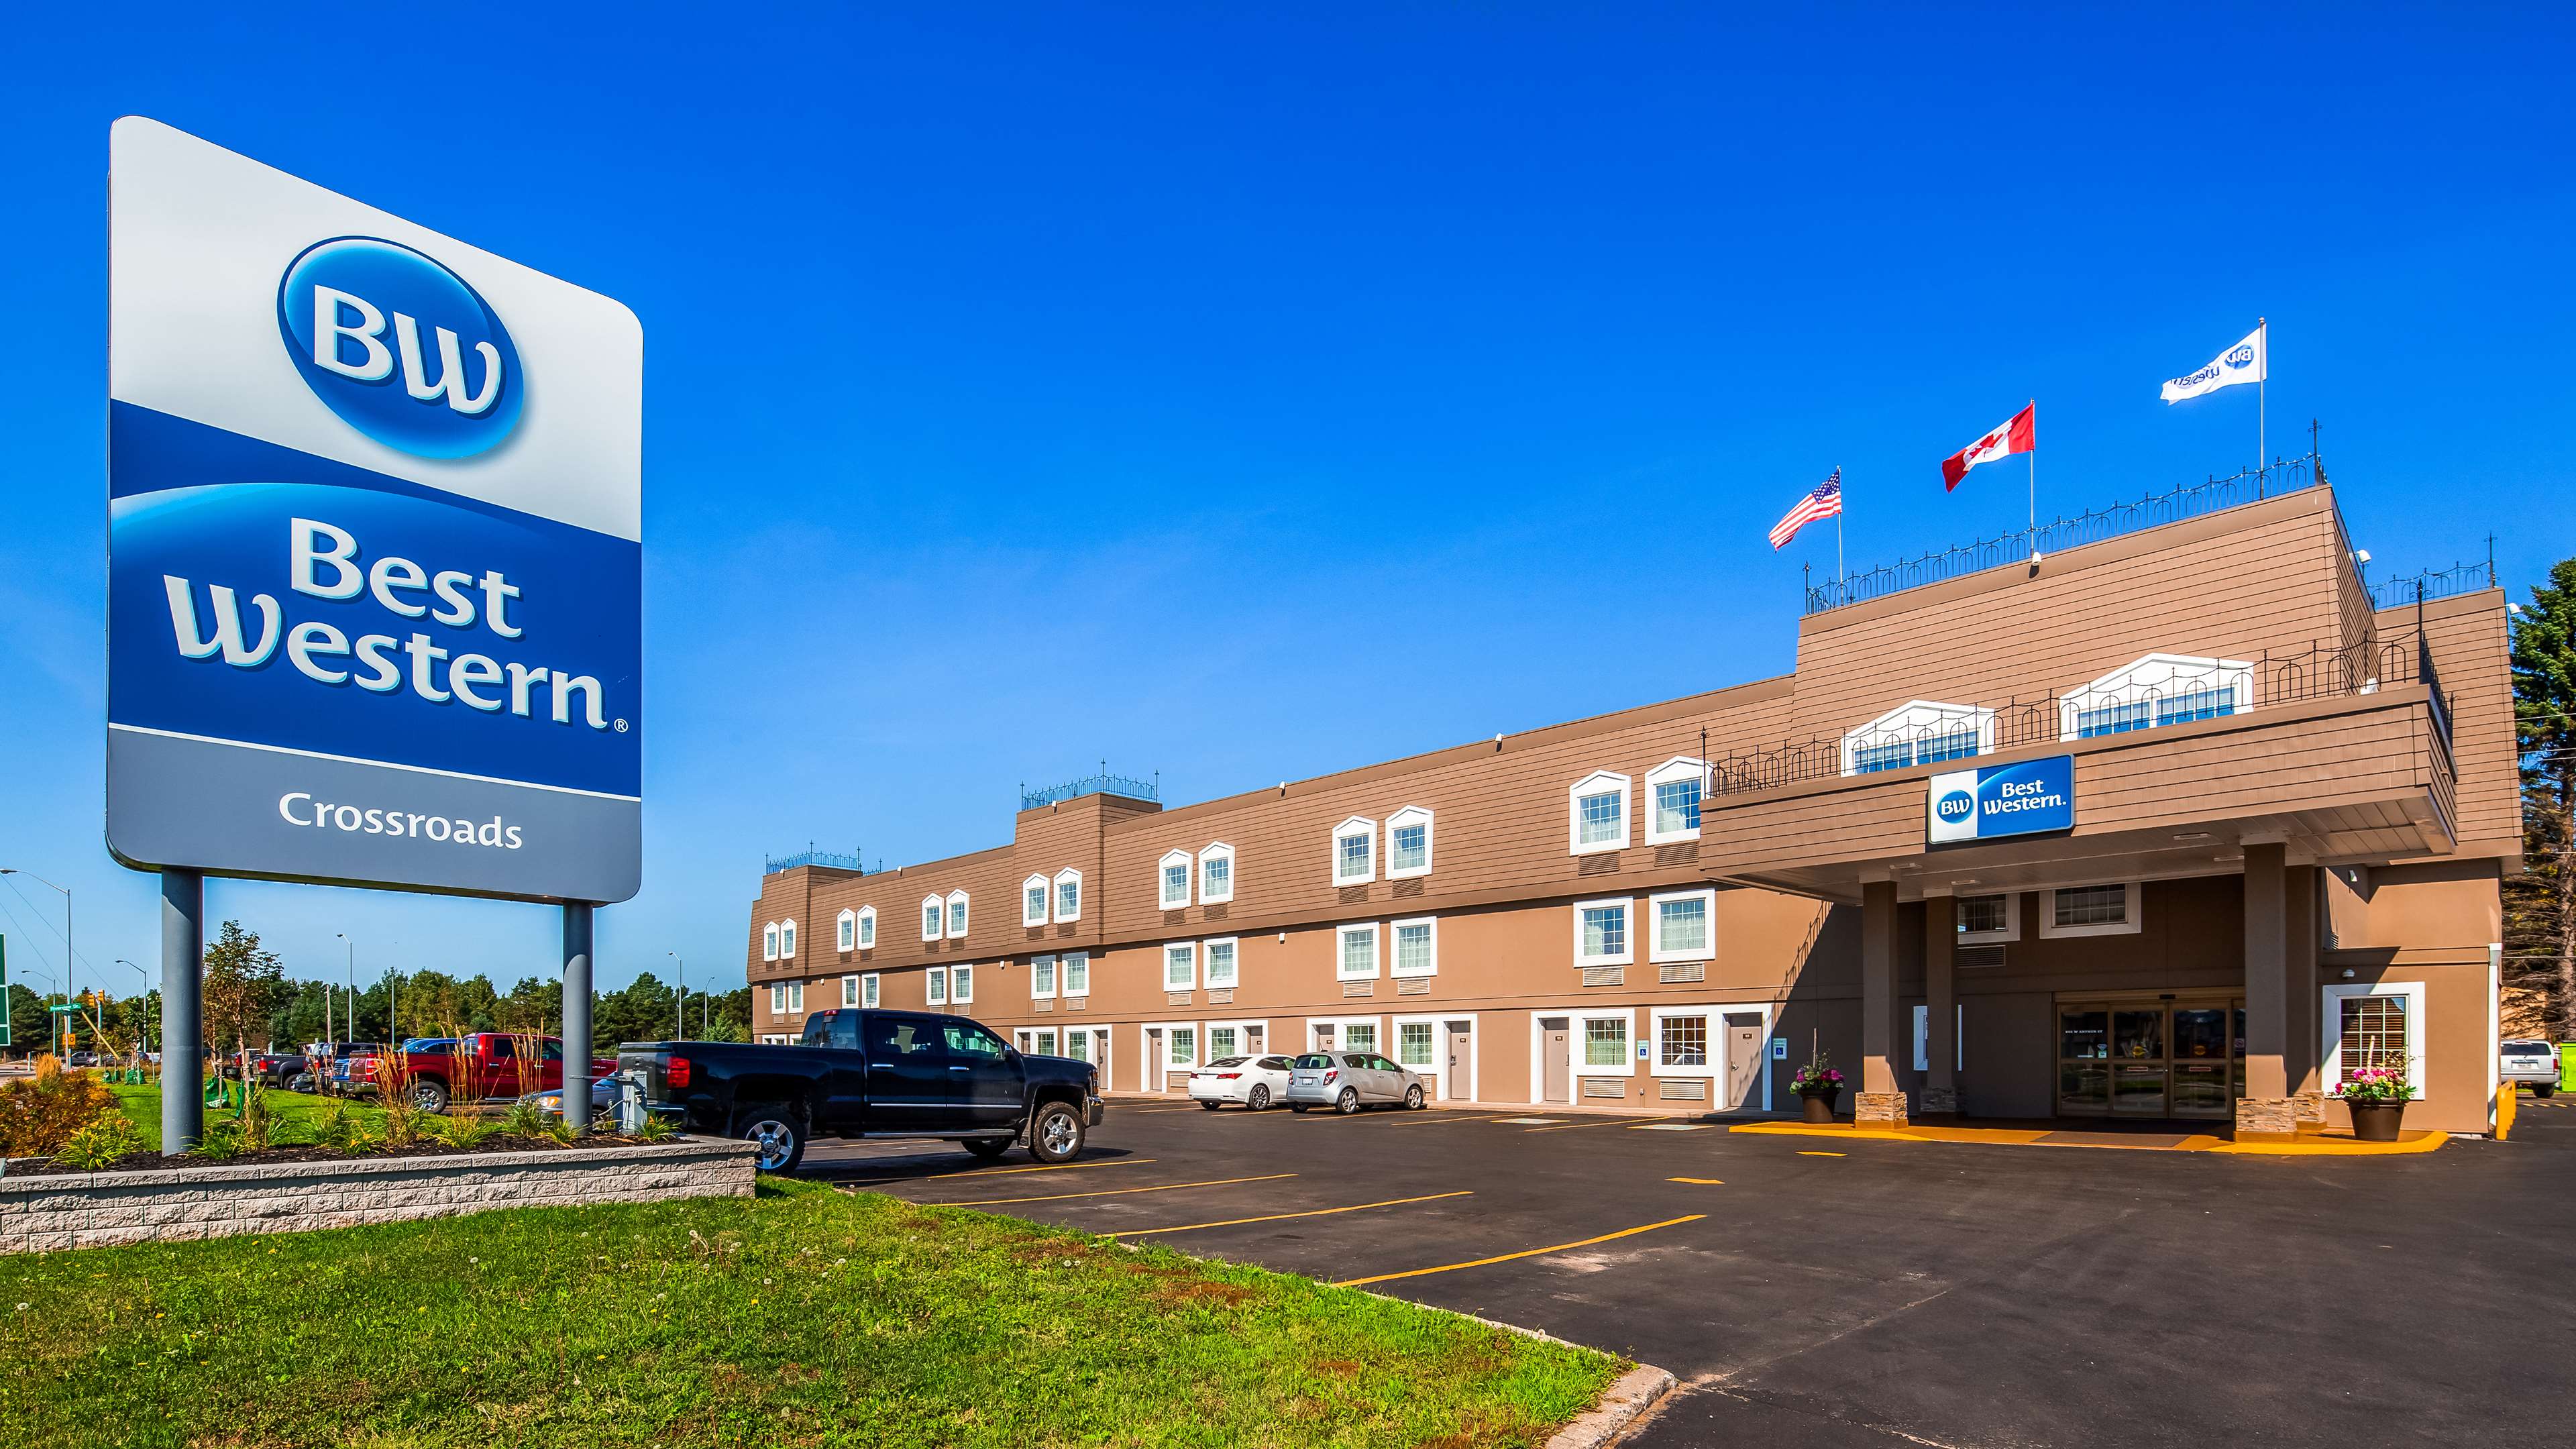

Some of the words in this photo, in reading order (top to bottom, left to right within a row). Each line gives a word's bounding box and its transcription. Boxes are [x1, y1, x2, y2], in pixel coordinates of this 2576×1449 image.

[313, 284, 501, 415] BW
[290, 517, 523, 639] Best
[1940, 798, 1970, 816] BW
[2001, 779, 2045, 798] Best
[278, 792, 523, 849] Crossroads
